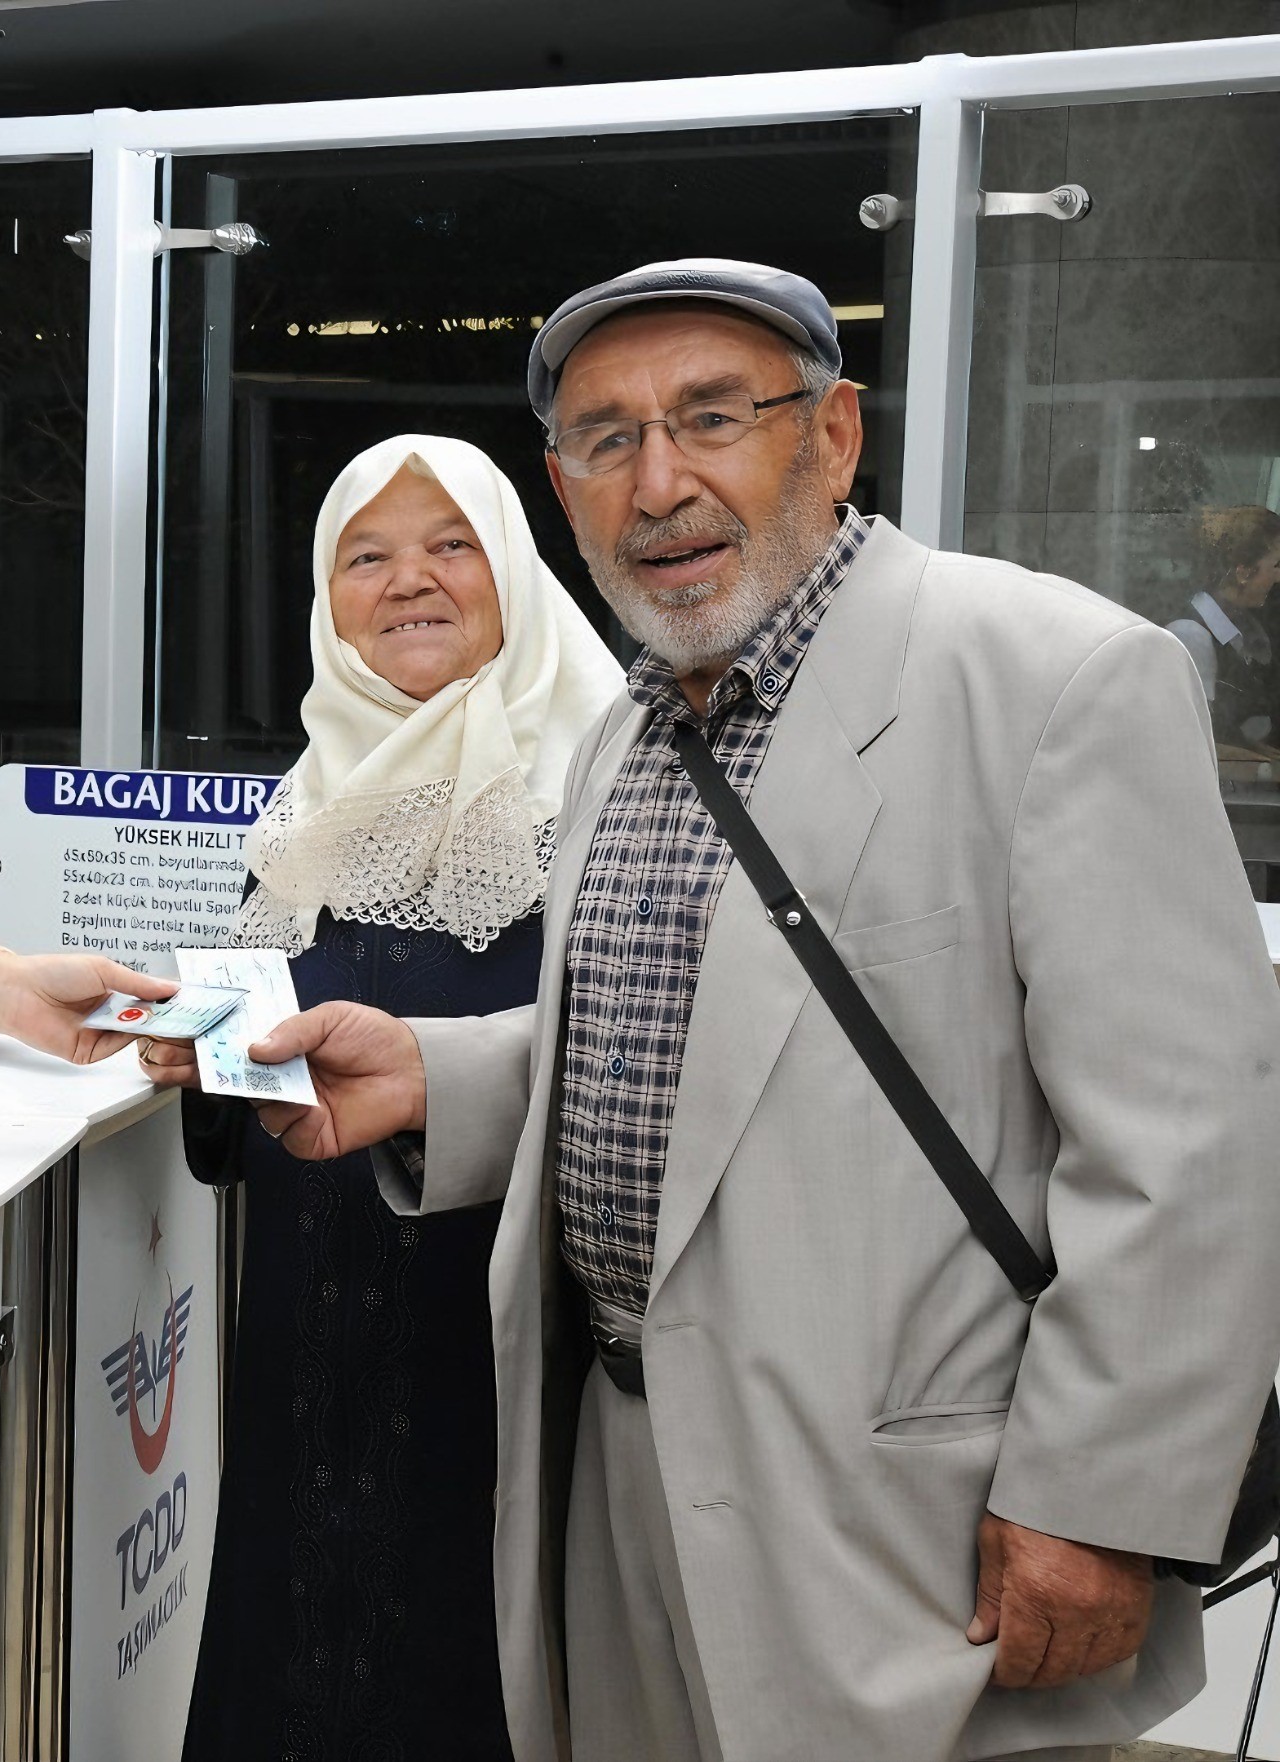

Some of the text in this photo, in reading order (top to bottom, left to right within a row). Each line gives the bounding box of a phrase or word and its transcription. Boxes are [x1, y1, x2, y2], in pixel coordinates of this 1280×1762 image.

[54, 770, 172, 819] BAGAJ
[114, 825, 182, 847] YÜKSEK
[187, 830, 230, 849] HIZLI
[130, 854, 154, 867] cm.
[62, 890, 70, 904] 2
[74, 892, 102, 908] adet
[107, 893, 147, 911] küçük
[62, 932, 79, 947] Bu
[116, 1471, 187, 1611] TCDD
